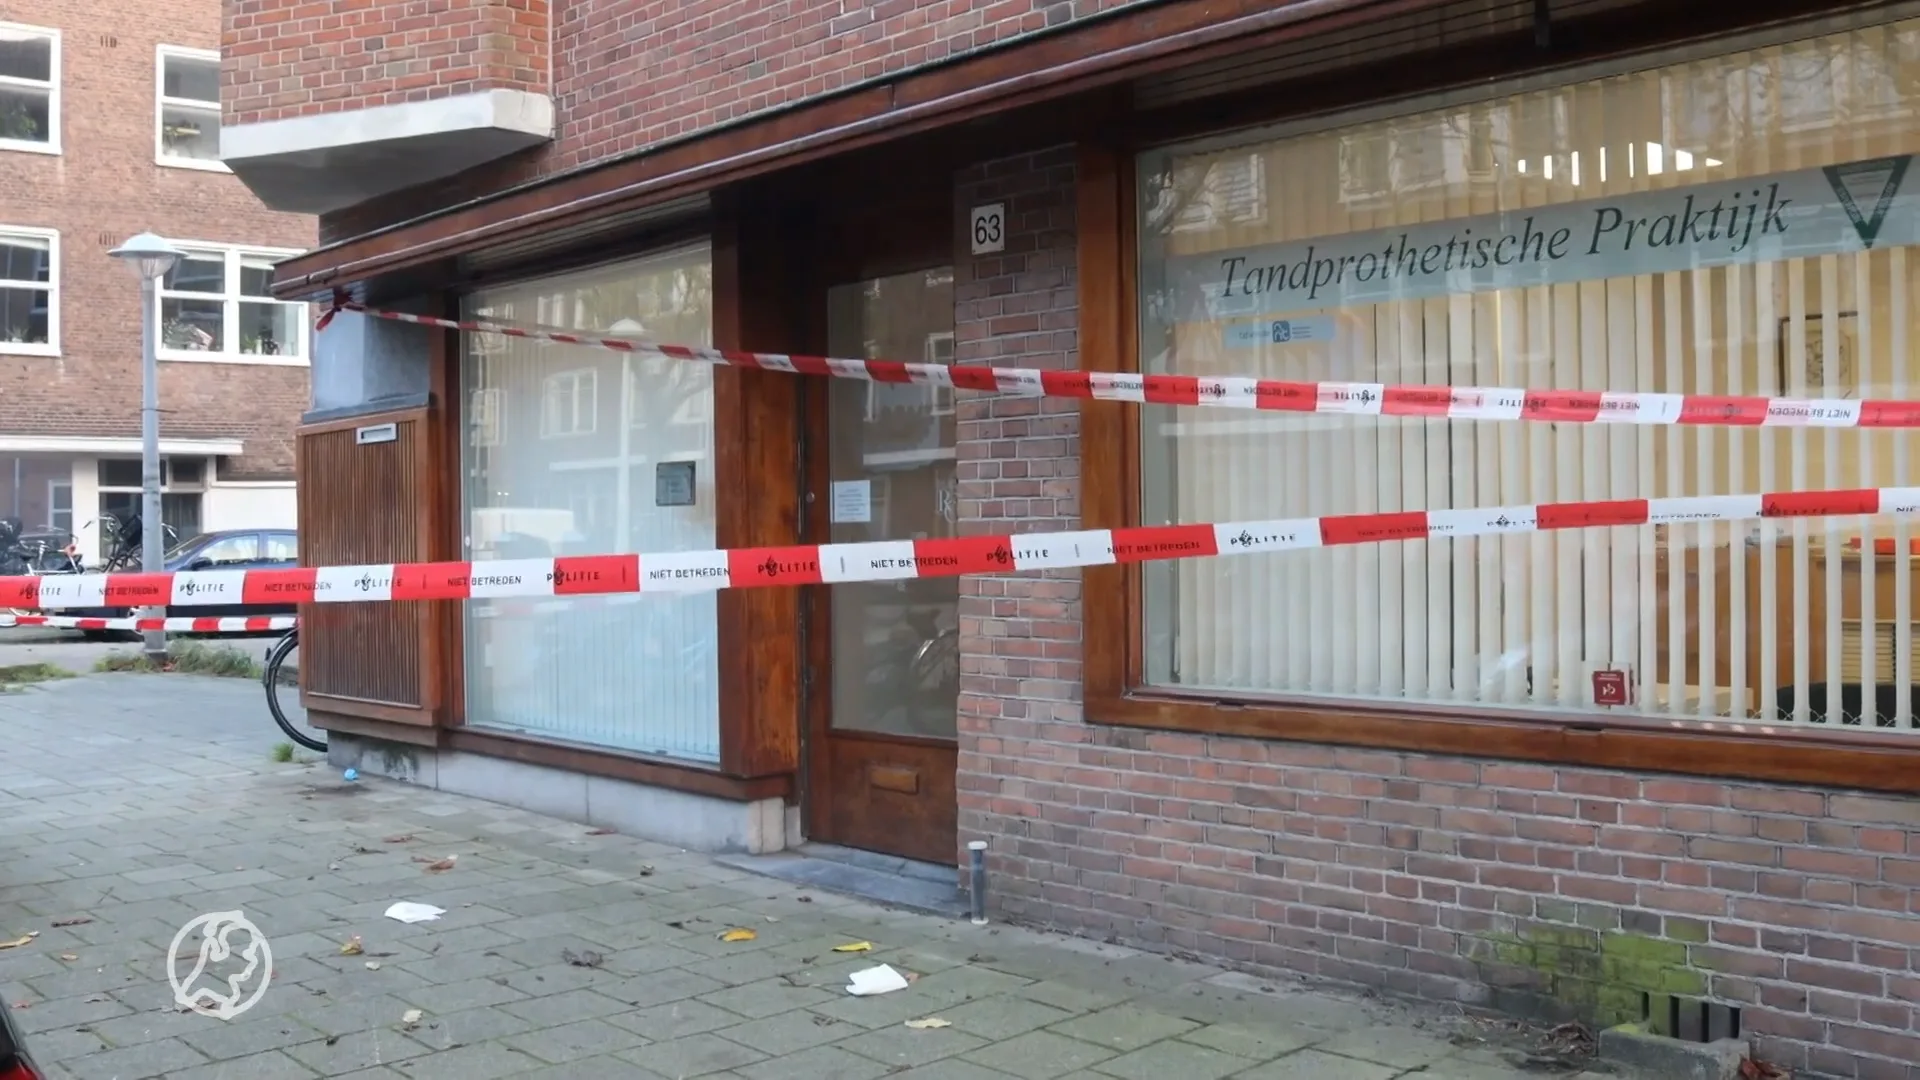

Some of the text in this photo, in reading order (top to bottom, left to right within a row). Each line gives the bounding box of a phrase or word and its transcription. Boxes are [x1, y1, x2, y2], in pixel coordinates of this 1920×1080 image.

[975, 214, 1000, 245] 63
[1220, 219, 1571, 301] Tandprothetische
[1589, 182, 1793, 256] Praktijk
[1334, 389, 1376, 405] POLITIE
[1620, 402, 1640, 410] NIET
[1769, 407, 1823, 417] BETREDEN
[1827, 409, 1850, 418] NIET
[179, 579, 225, 596] POLITIE
[354, 571, 403, 591] POLITIE
[447, 576, 468, 587] NIET
[471, 575, 522, 586] BETREDEN
[546, 564, 600, 587] POLITIE
[650, 570, 672, 580] NIET
[675, 566, 731, 579] BETREDEN
[757, 555, 816, 577] POLITIE
[870, 558, 894, 569] NIET
[898, 556, 958, 569] BETREDEN
[986, 543, 1049, 564] POLITIE
[1230, 529, 1297, 547] POLITIE
